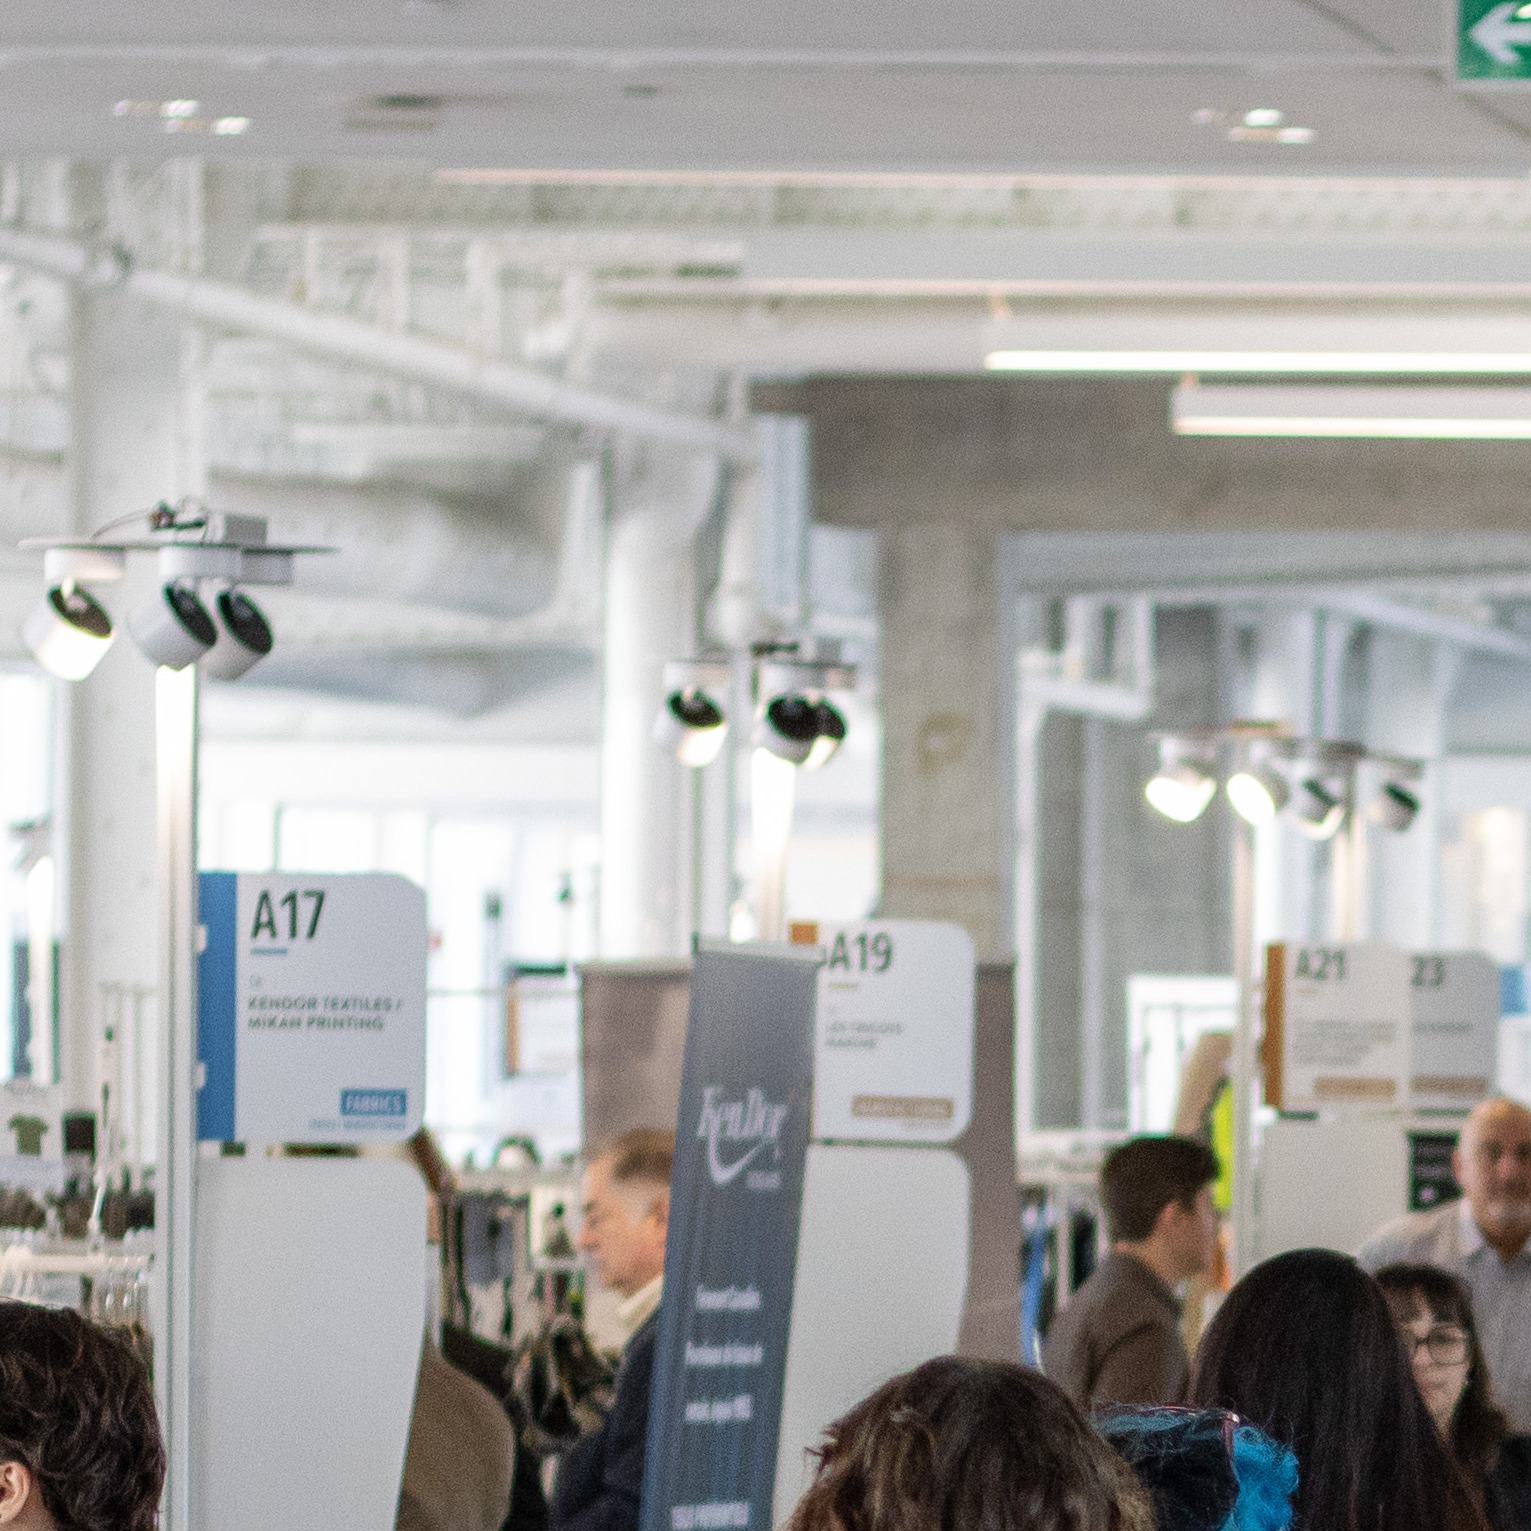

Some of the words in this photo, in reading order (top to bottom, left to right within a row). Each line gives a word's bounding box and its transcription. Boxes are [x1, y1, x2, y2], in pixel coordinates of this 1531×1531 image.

[250, 889, 326, 939] A17
[829, 931, 894, 973] A19
[1295, 948, 1346, 981] A21
[1411, 955, 1445, 986] 23
[248, 996, 317, 1010] KENDOR
[323, 996, 392, 1011] TEXTILES
[307, 1016, 384, 1031] PRINTING
[346, 1095, 401, 1112] FABRICS
